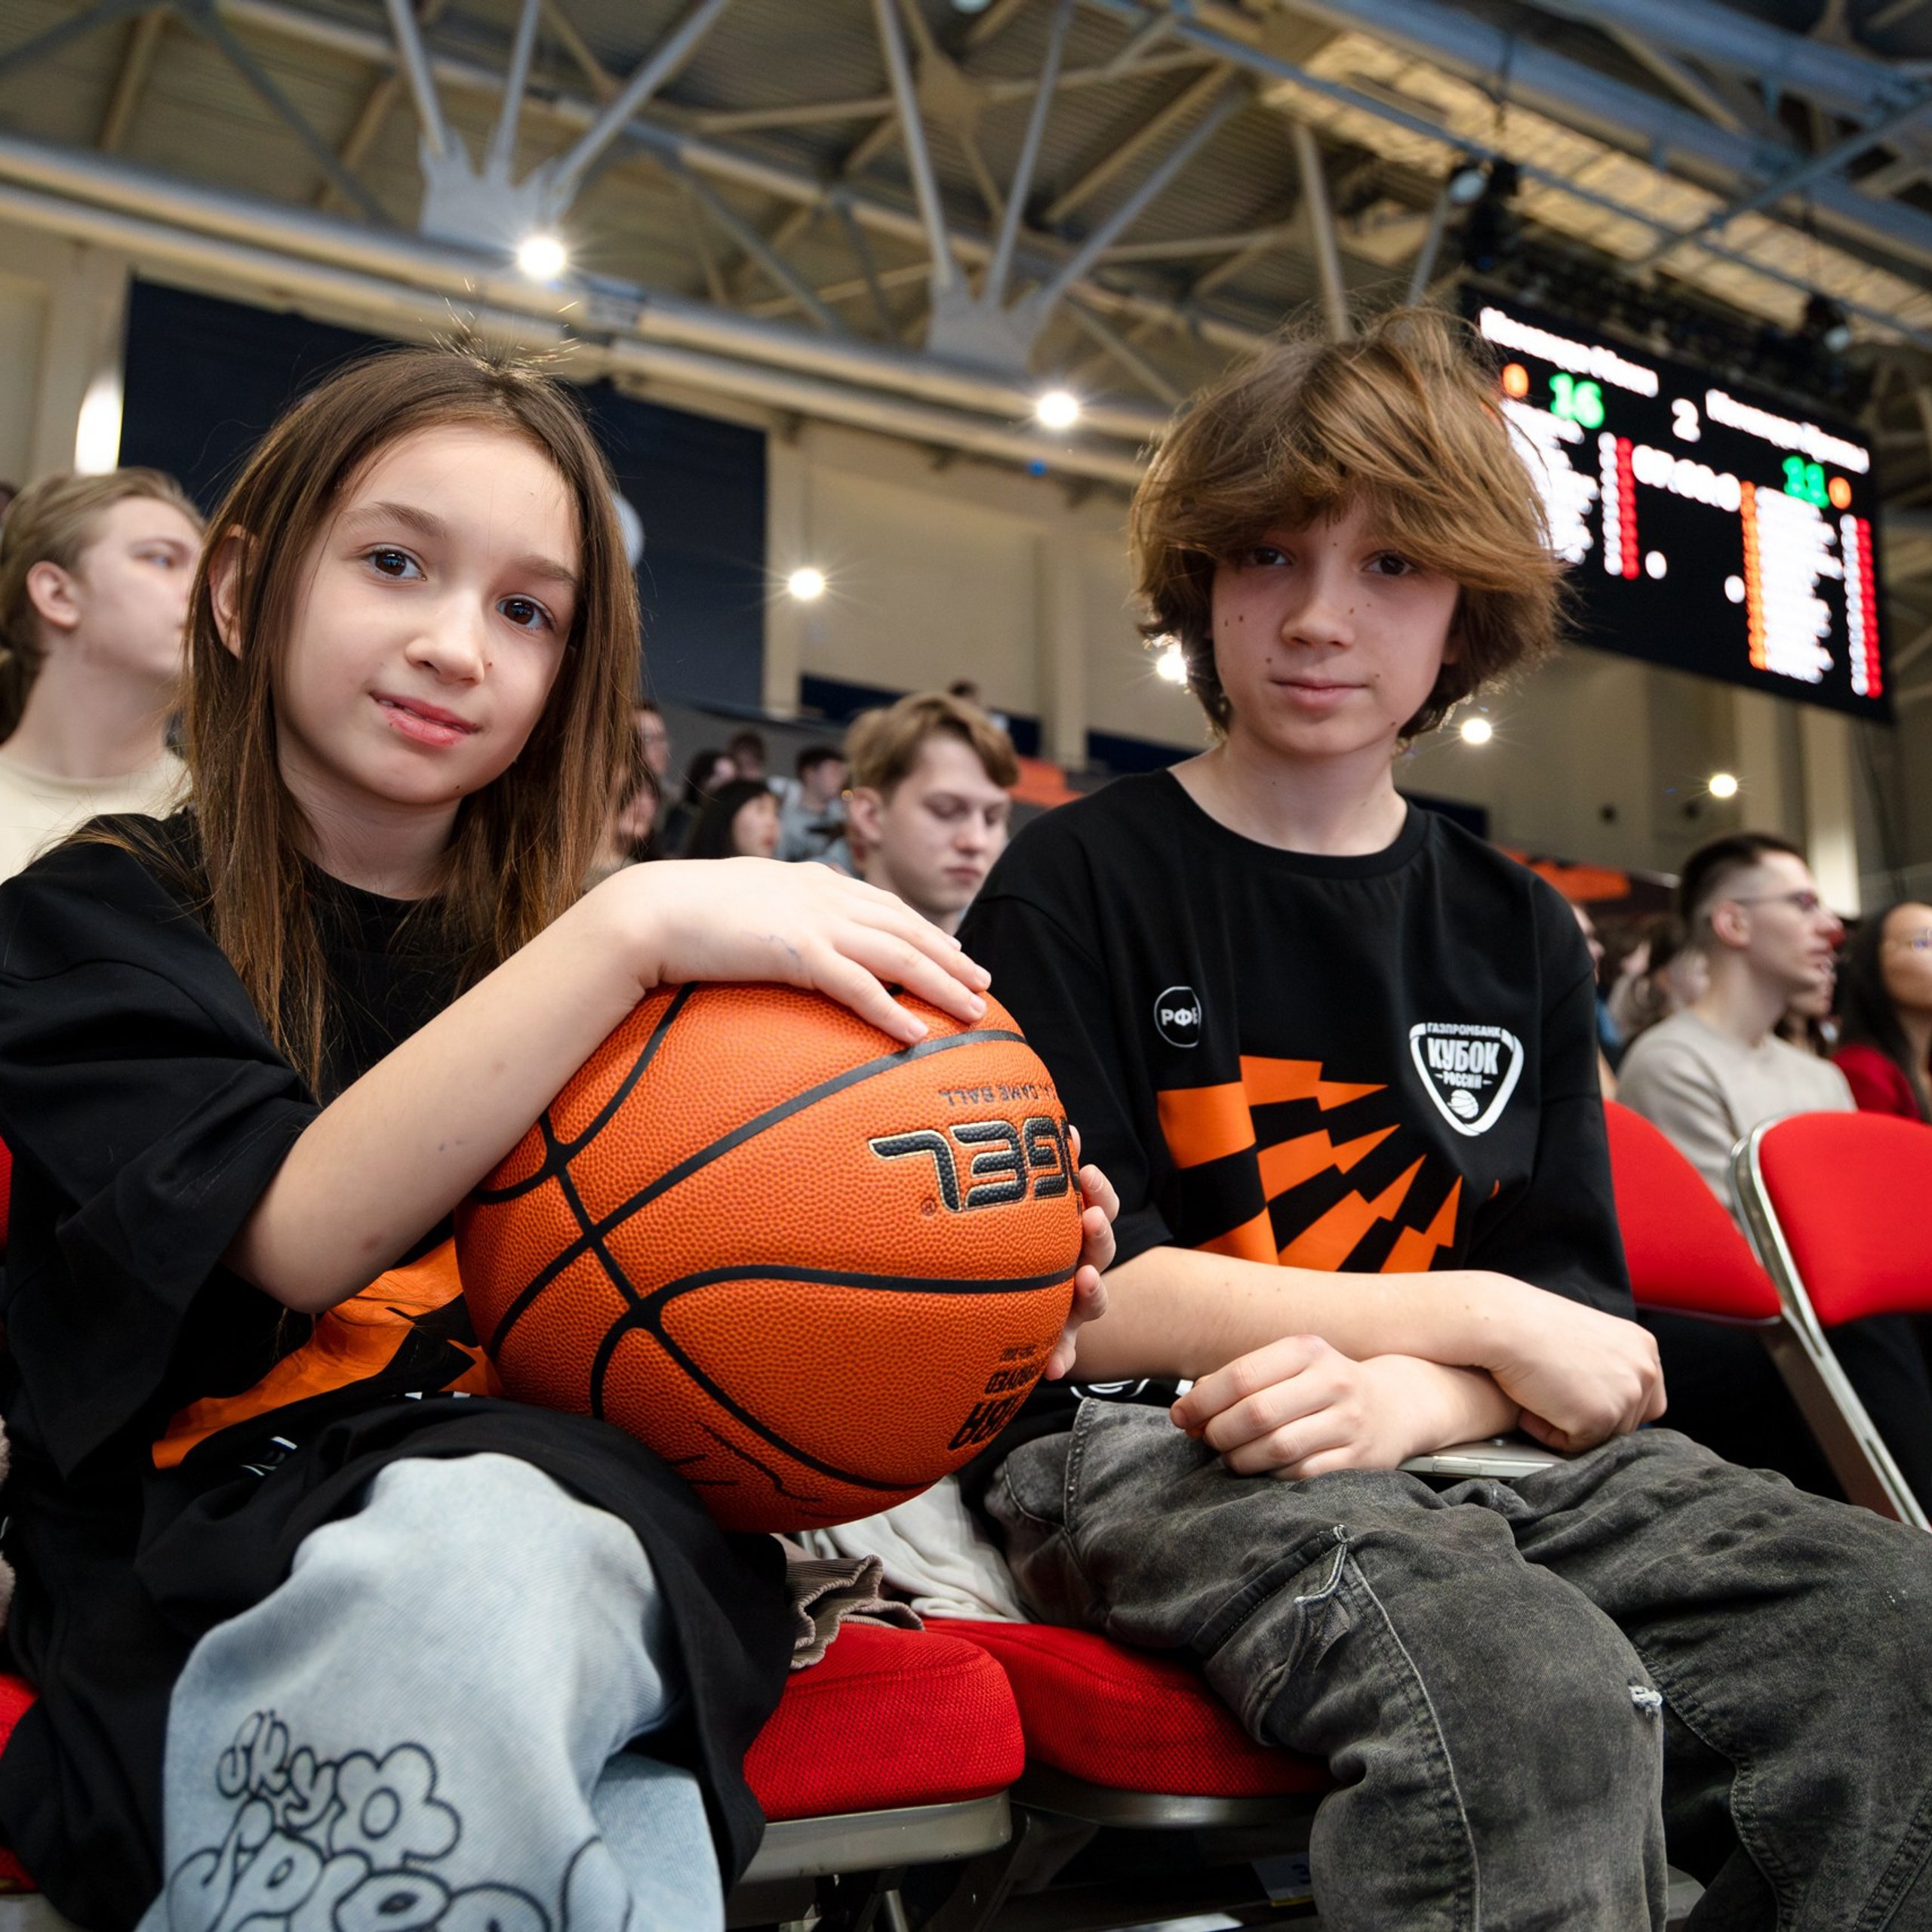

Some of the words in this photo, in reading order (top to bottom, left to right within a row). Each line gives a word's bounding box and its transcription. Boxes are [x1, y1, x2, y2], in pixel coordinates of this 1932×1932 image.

[1671, 398, 1702, 443] 2
[1426, 1022, 1502, 1038] ГАЗПРОМБАНК
[1427, 1037, 1500, 1075] КУБОК
[1442, 1071, 1483, 1089] РОССИИ
[938, 1086, 995, 1106] BALL
